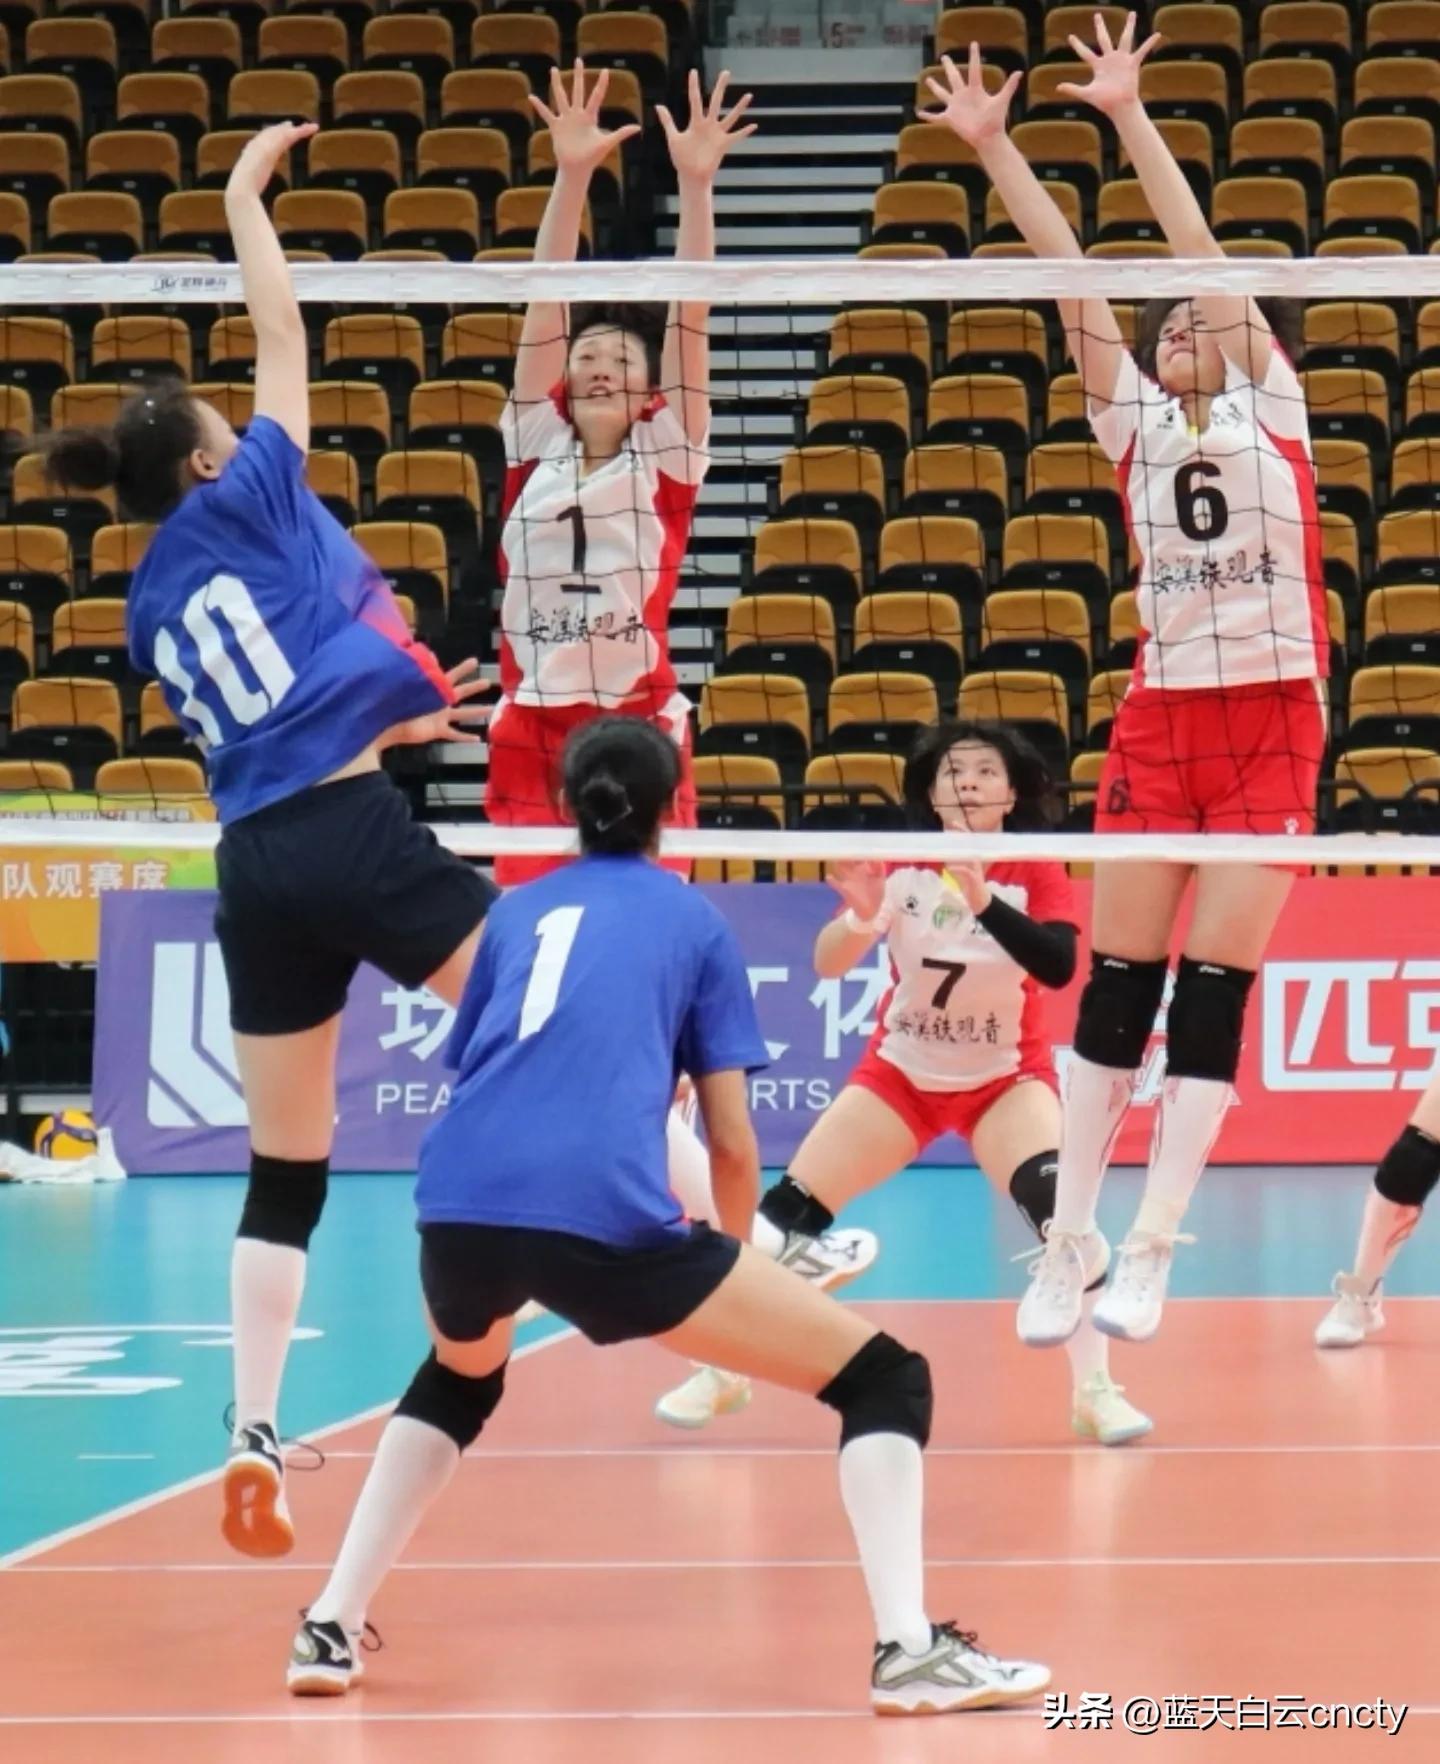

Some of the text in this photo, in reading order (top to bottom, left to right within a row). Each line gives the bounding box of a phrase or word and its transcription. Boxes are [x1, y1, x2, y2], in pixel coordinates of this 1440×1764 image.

[1174, 461, 1228, 541] 6
[556, 505, 587, 572] 1
[153, 574, 296, 748] 10
[518, 906, 585, 1041] 1
[922, 957, 967, 1009] 7
[376, 1078, 831, 1115] PEA RTS
